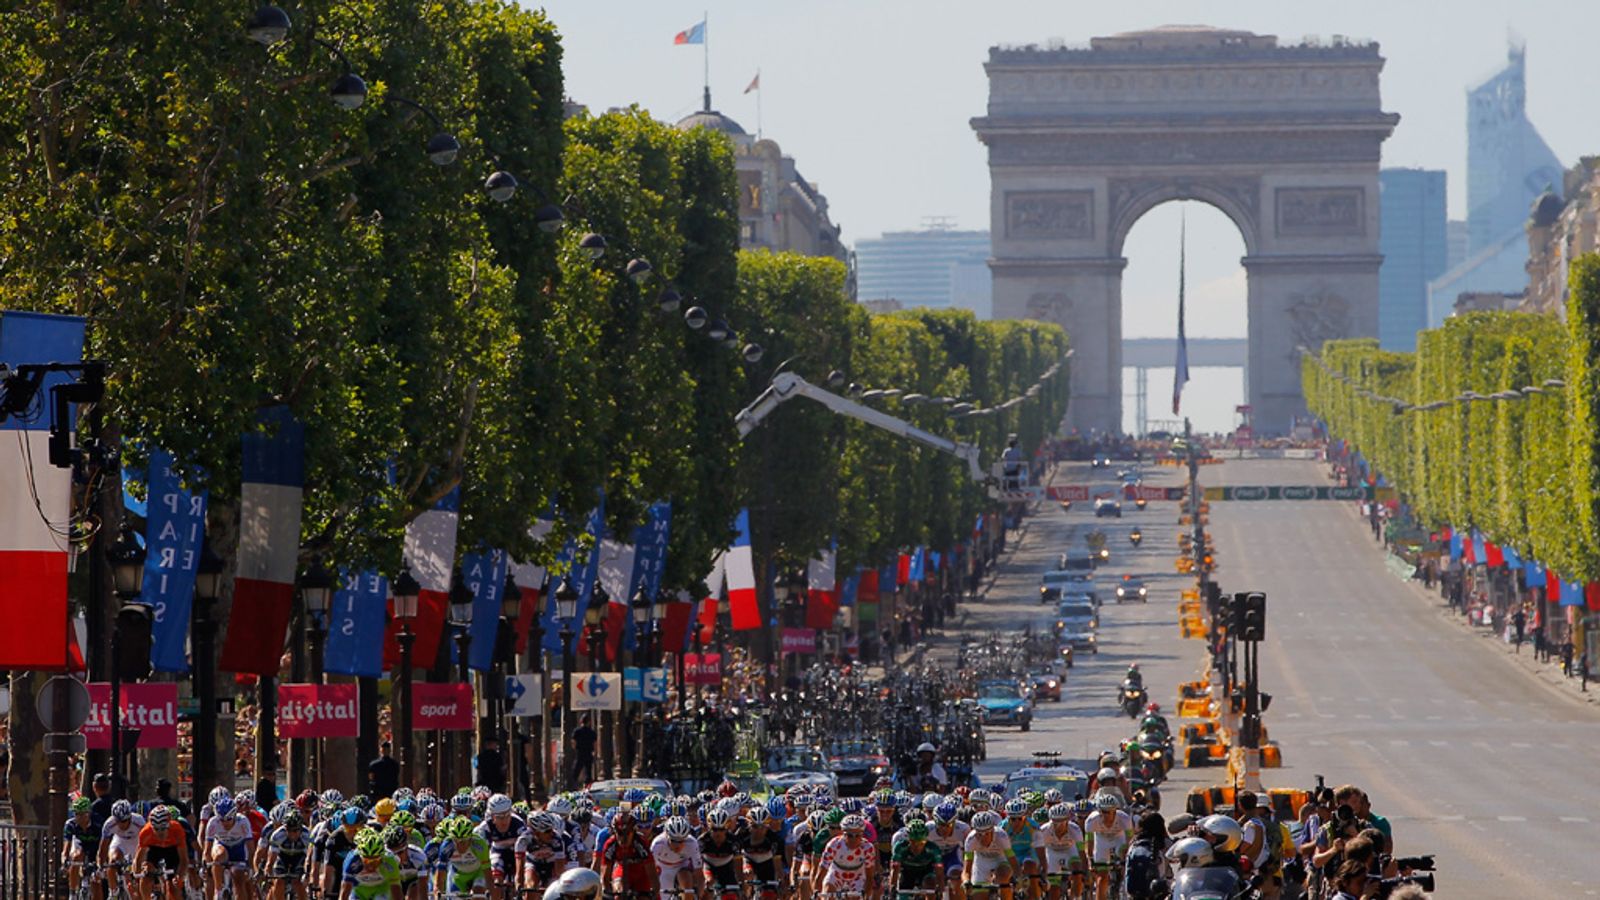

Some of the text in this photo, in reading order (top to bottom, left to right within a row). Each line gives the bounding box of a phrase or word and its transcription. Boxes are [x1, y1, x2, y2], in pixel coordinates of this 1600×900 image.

[685, 661, 720, 677] igital
[84, 701, 175, 726] diital
[281, 699, 356, 725] digital
[420, 703, 458, 718] sport
